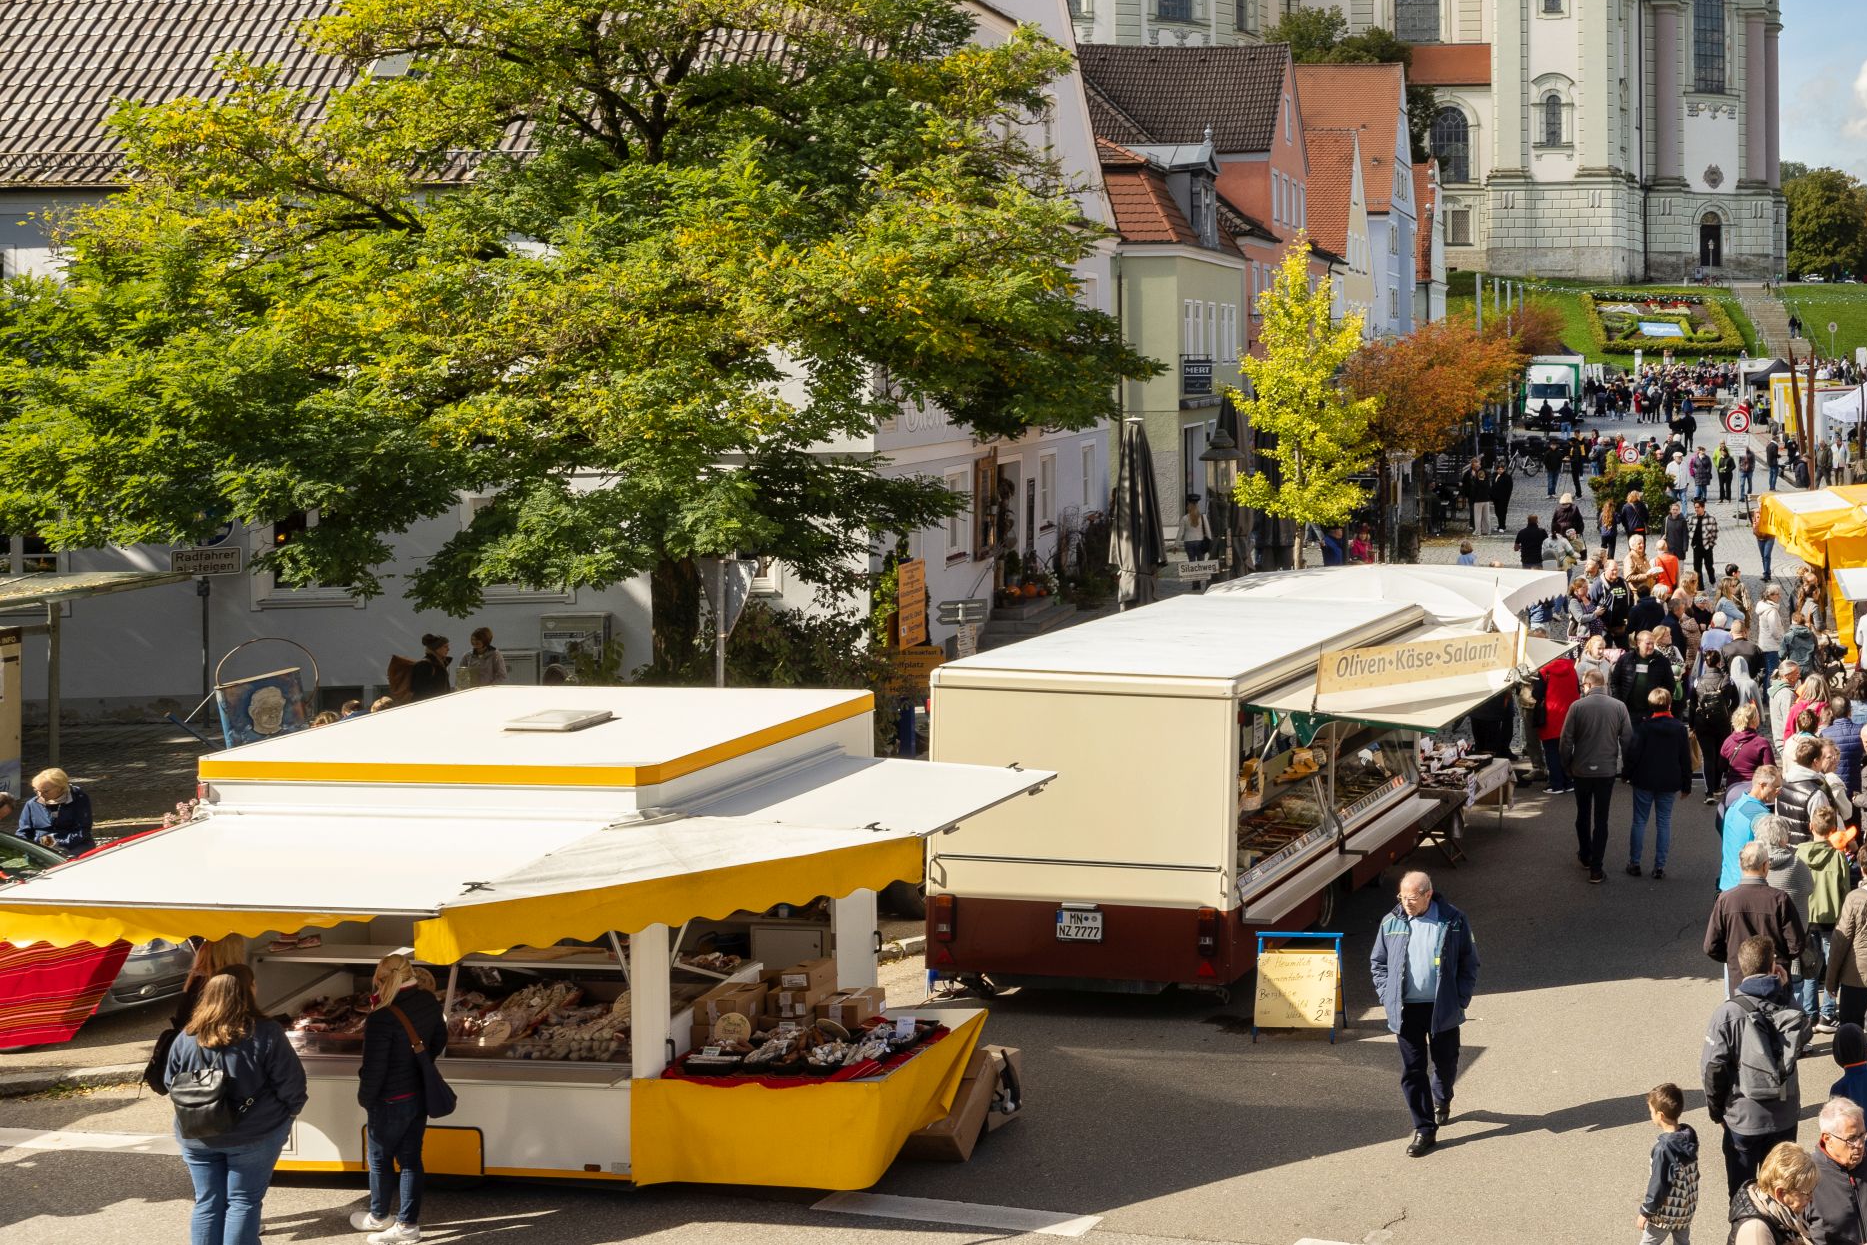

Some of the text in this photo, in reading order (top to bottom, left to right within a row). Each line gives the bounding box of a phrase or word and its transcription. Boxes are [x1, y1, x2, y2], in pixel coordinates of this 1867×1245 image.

[1185, 366, 1210, 374] MERT
[176, 551, 236, 562] Radfahrer
[1181, 563, 1217, 573] Silachweg
[1336, 638, 1500, 678] Oliven Käse Salami
[1070, 913, 1083, 925] MN
[1059, 925, 1100, 938] NZ 7777
